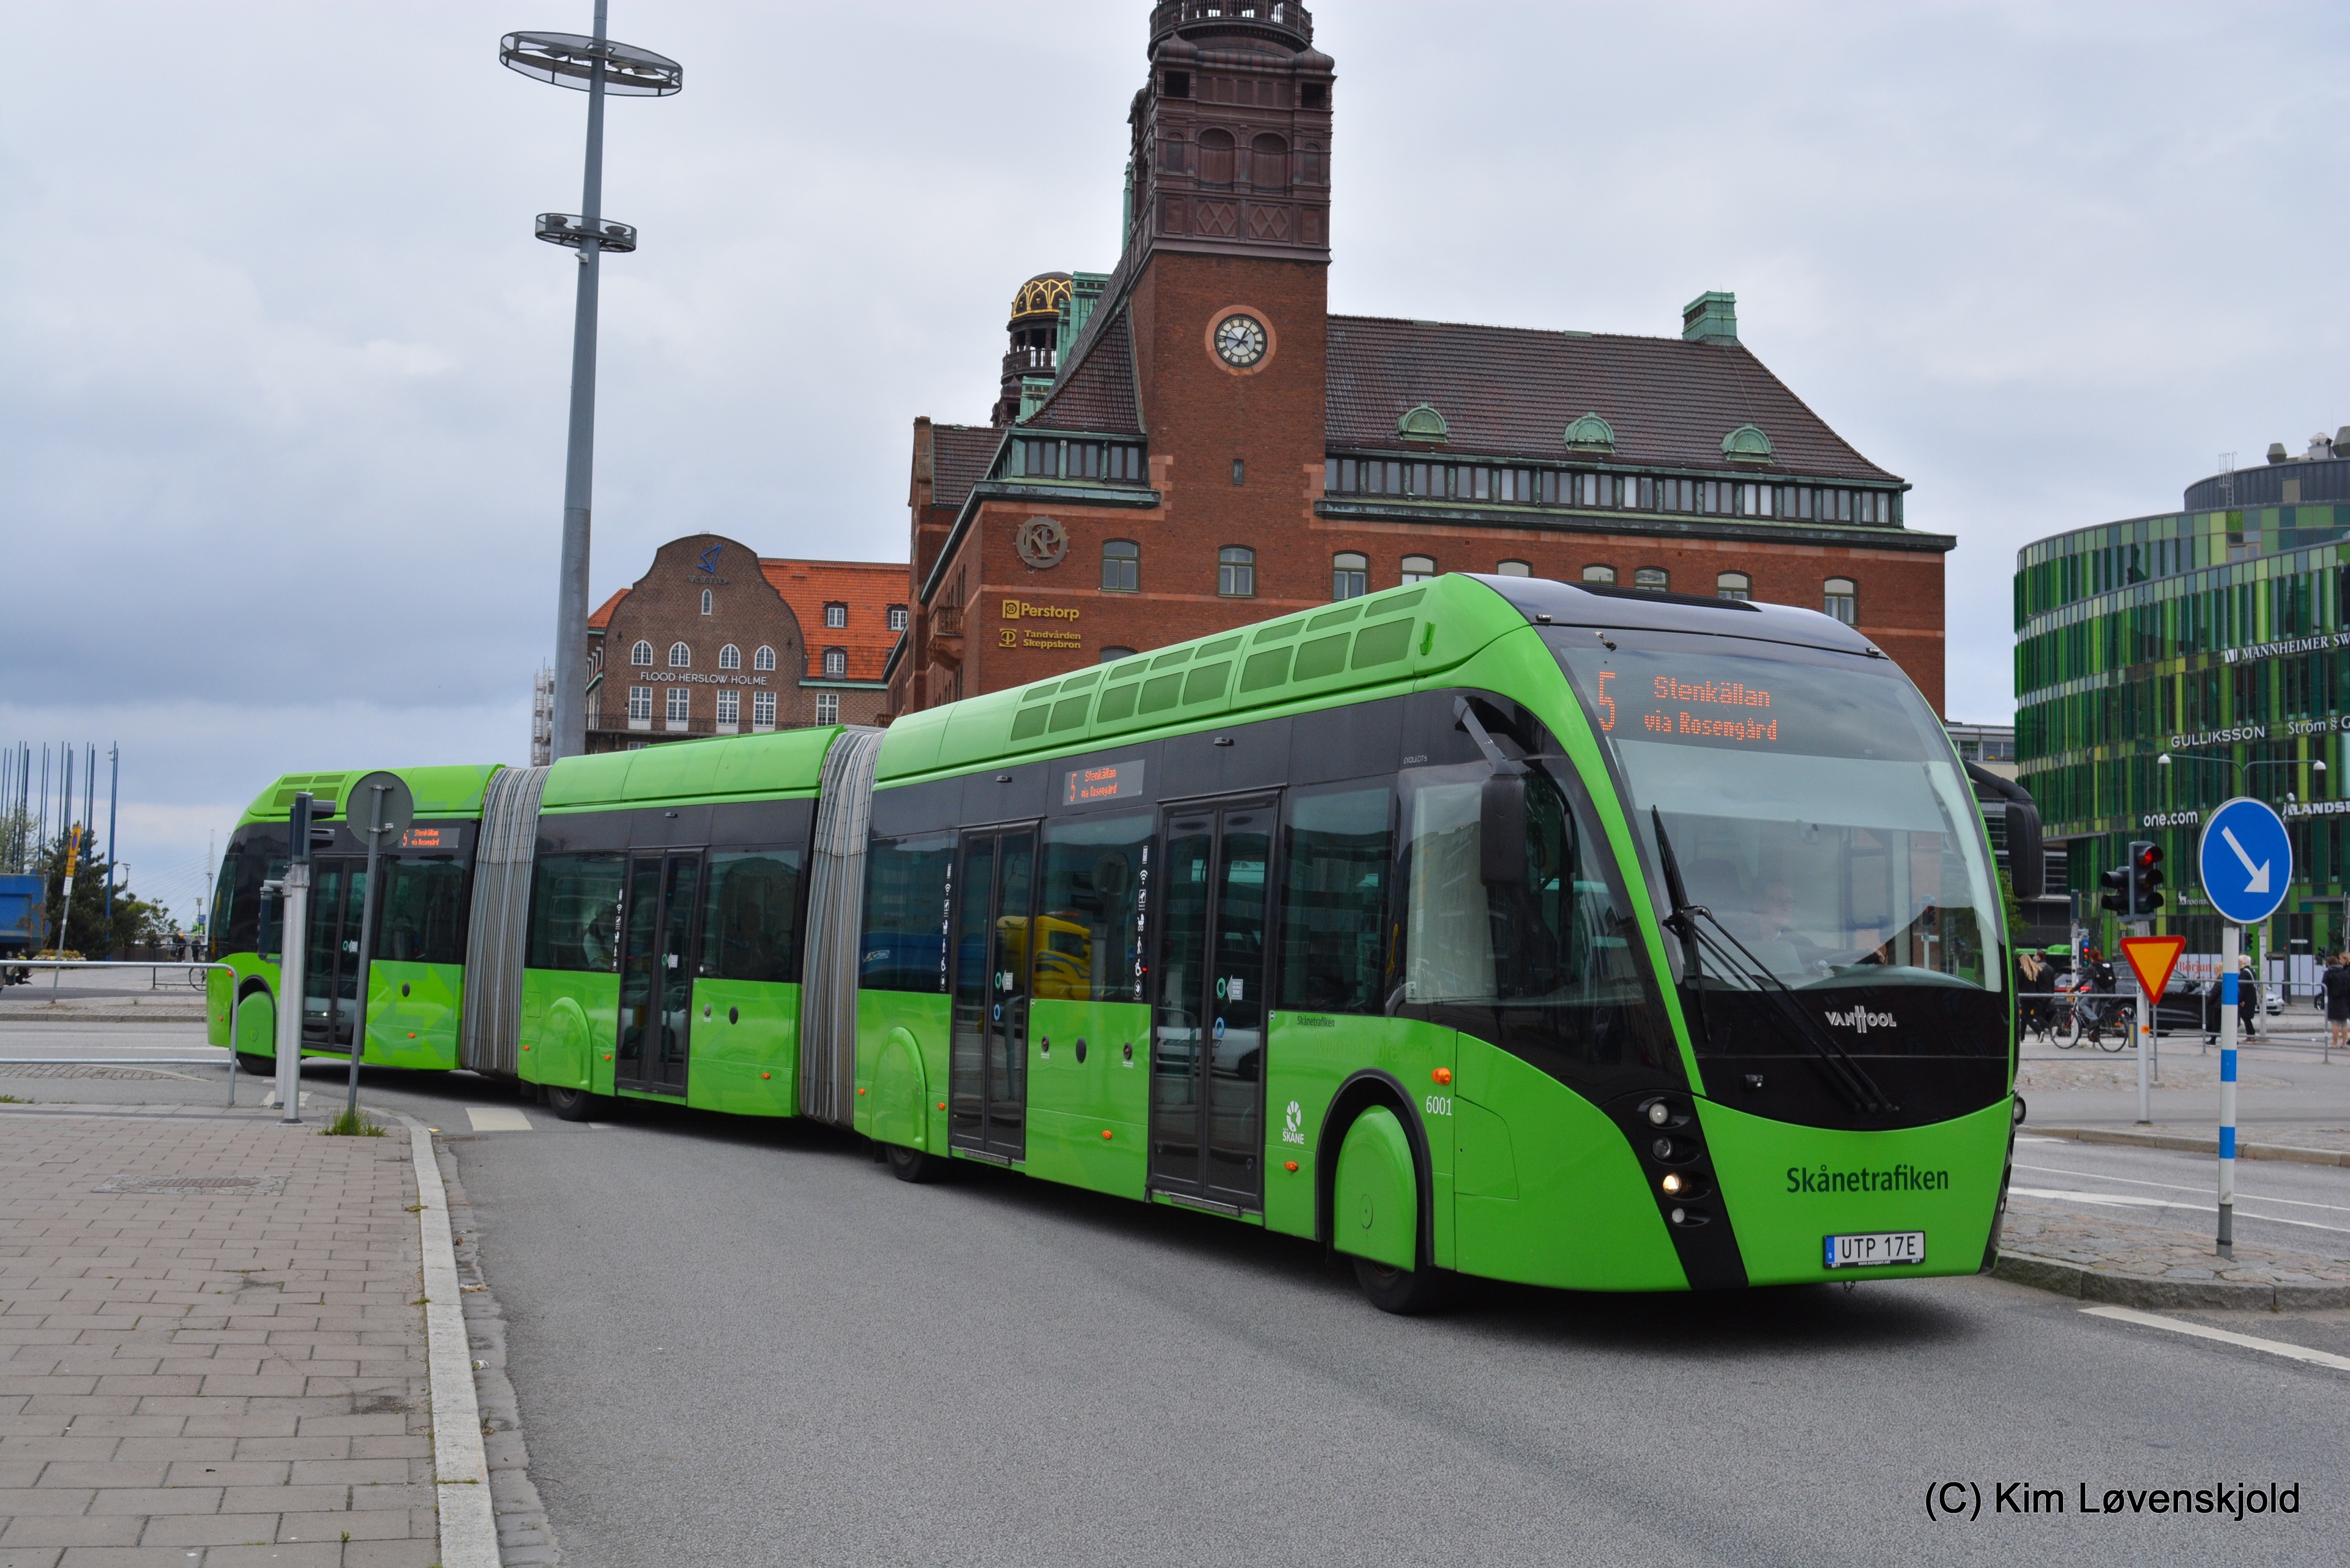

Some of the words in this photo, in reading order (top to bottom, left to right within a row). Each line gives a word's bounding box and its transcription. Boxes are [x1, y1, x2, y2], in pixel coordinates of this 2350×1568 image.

[1021, 603, 1080, 621] Perstorp
[1023, 639, 1081, 649] Skeppsbron
[1024, 630, 1081, 640] Tandvården
[2242, 636, 2329, 660] MANNHEIMER
[641, 672, 675, 681] FLOOD
[679, 673, 728, 684] HERSLOW
[731, 676, 767, 685] HOLME
[1598, 671, 1616, 731] 5
[1654, 676, 1770, 707] Stenkällan
[1644, 709, 1672, 732] via
[1680, 712, 1777, 741] Rosengård
[2288, 719, 2326, 734] Ström
[2171, 726, 2264, 747] GULLIKSSON
[2144, 811, 2198, 827] one.com
[2179, 960, 2211, 974] Början
[1297, 1015, 1335, 1028] Skånetrafiken
[1426, 1096, 1452, 1116] 6001
[1786, 1164, 1949, 1193] Skånetrafiken
[1842, 1238, 1876, 1259] UTP
[1884, 1236, 1915, 1256] 17E
